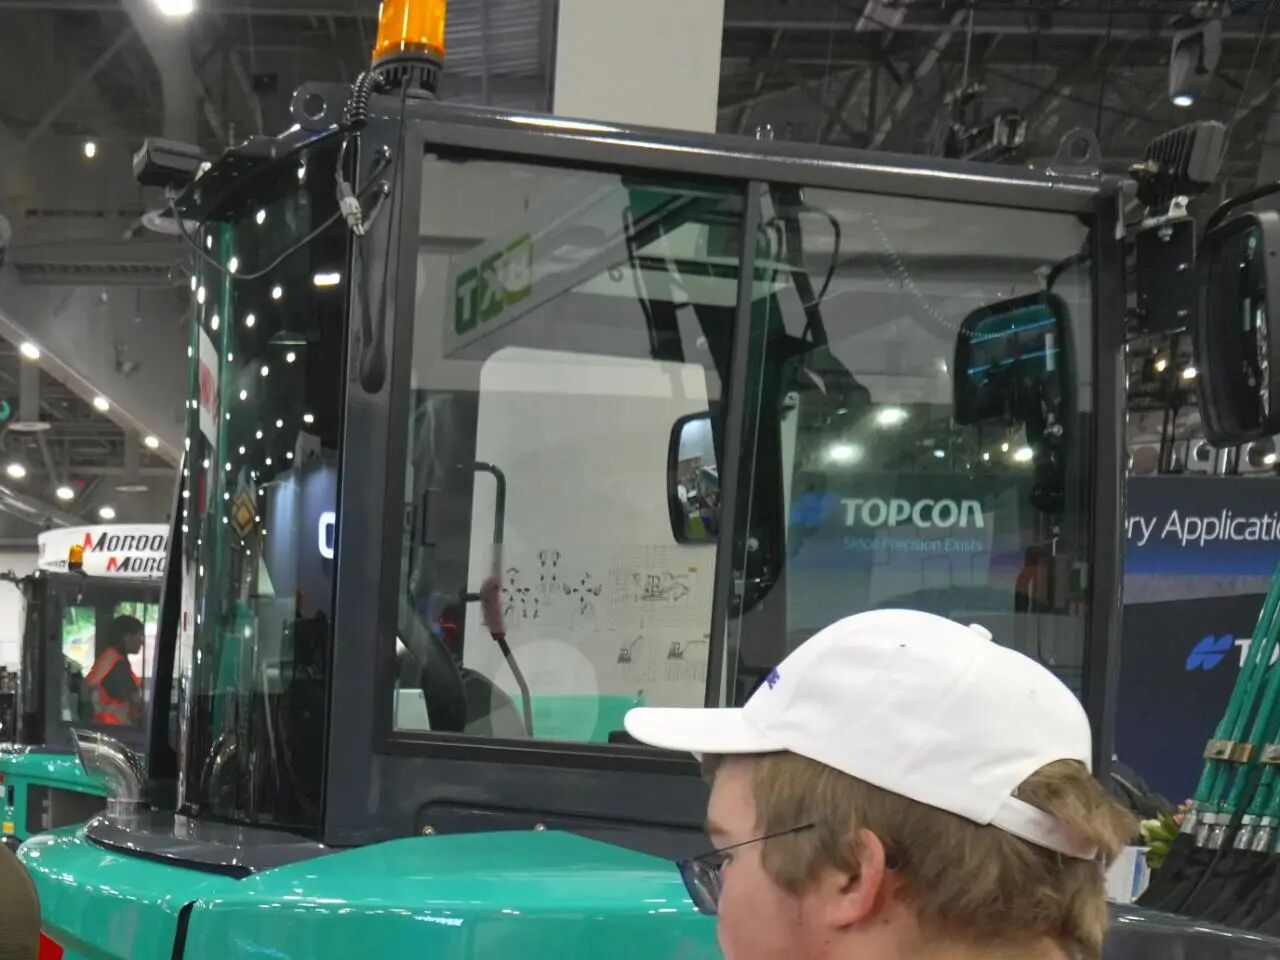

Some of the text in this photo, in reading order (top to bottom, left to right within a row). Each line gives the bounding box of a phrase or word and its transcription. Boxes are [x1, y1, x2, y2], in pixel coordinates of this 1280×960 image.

[840, 498, 985, 528] TOPCON
[83, 532, 168, 553] MOROO
[1126, 509, 1280, 548] ry Applicati
